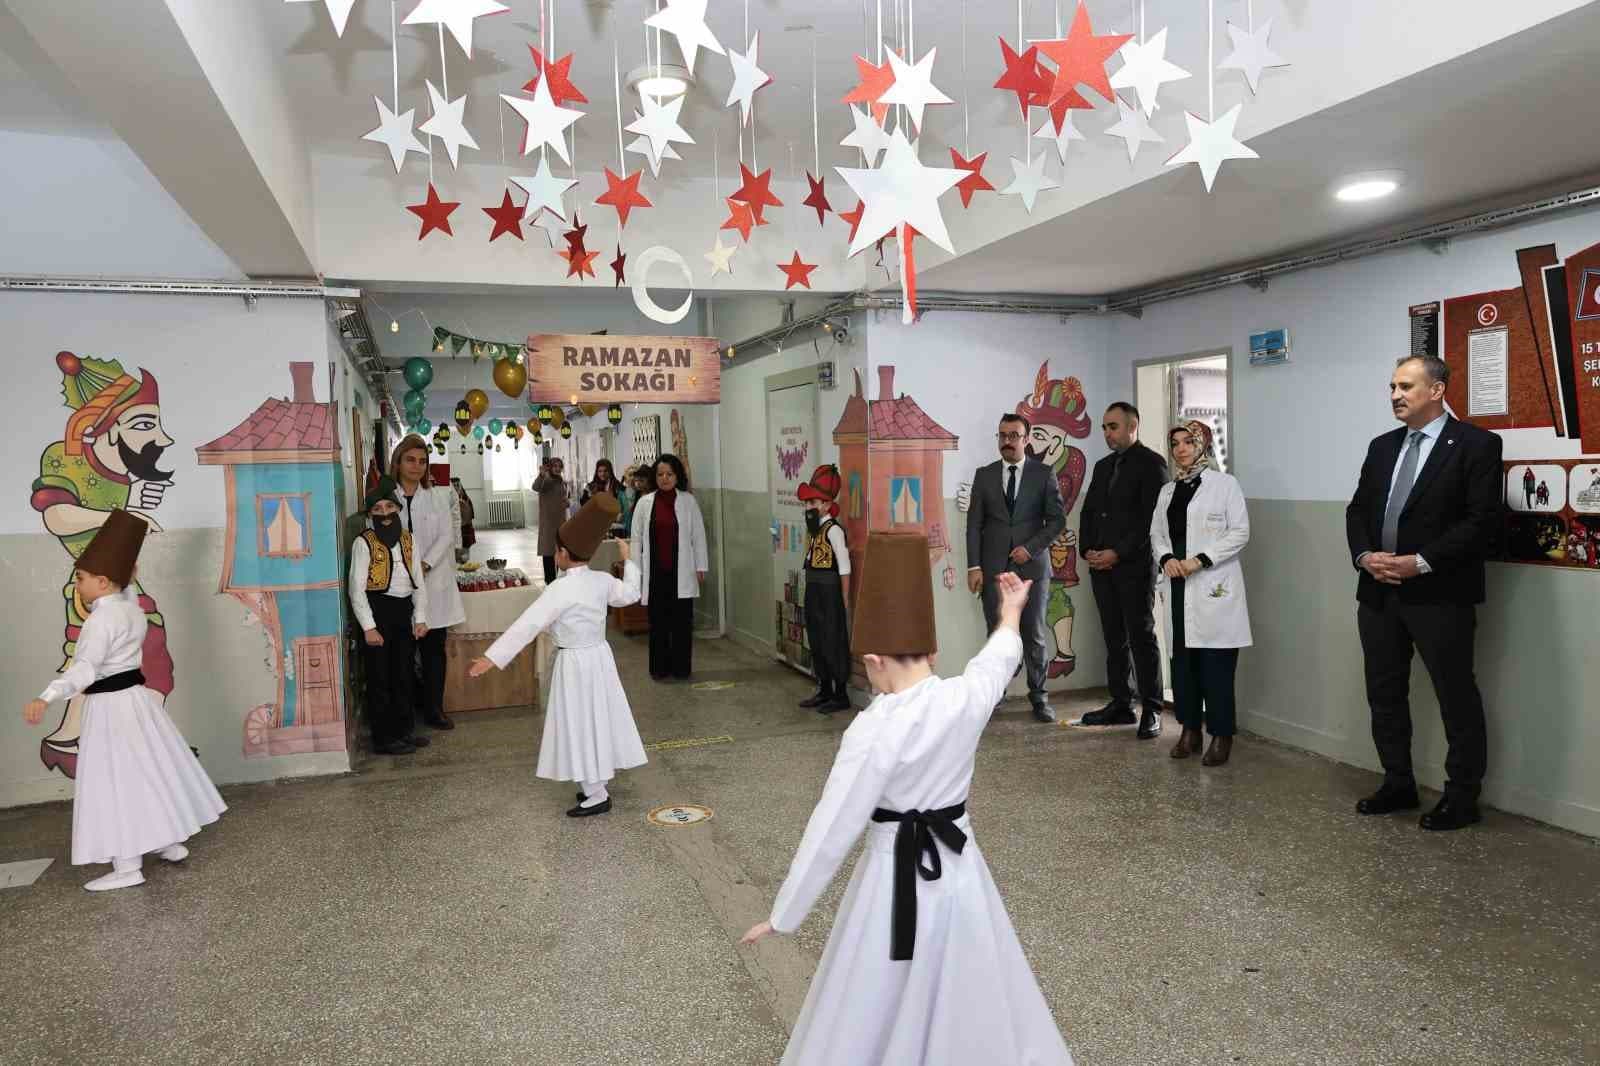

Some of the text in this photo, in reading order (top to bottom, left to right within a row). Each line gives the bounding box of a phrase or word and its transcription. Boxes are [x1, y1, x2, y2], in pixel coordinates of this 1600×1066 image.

[563, 346, 691, 367] RAMAZAN
[1582, 343, 1593, 353] 15
[580, 369, 675, 391] SOKAĞI
